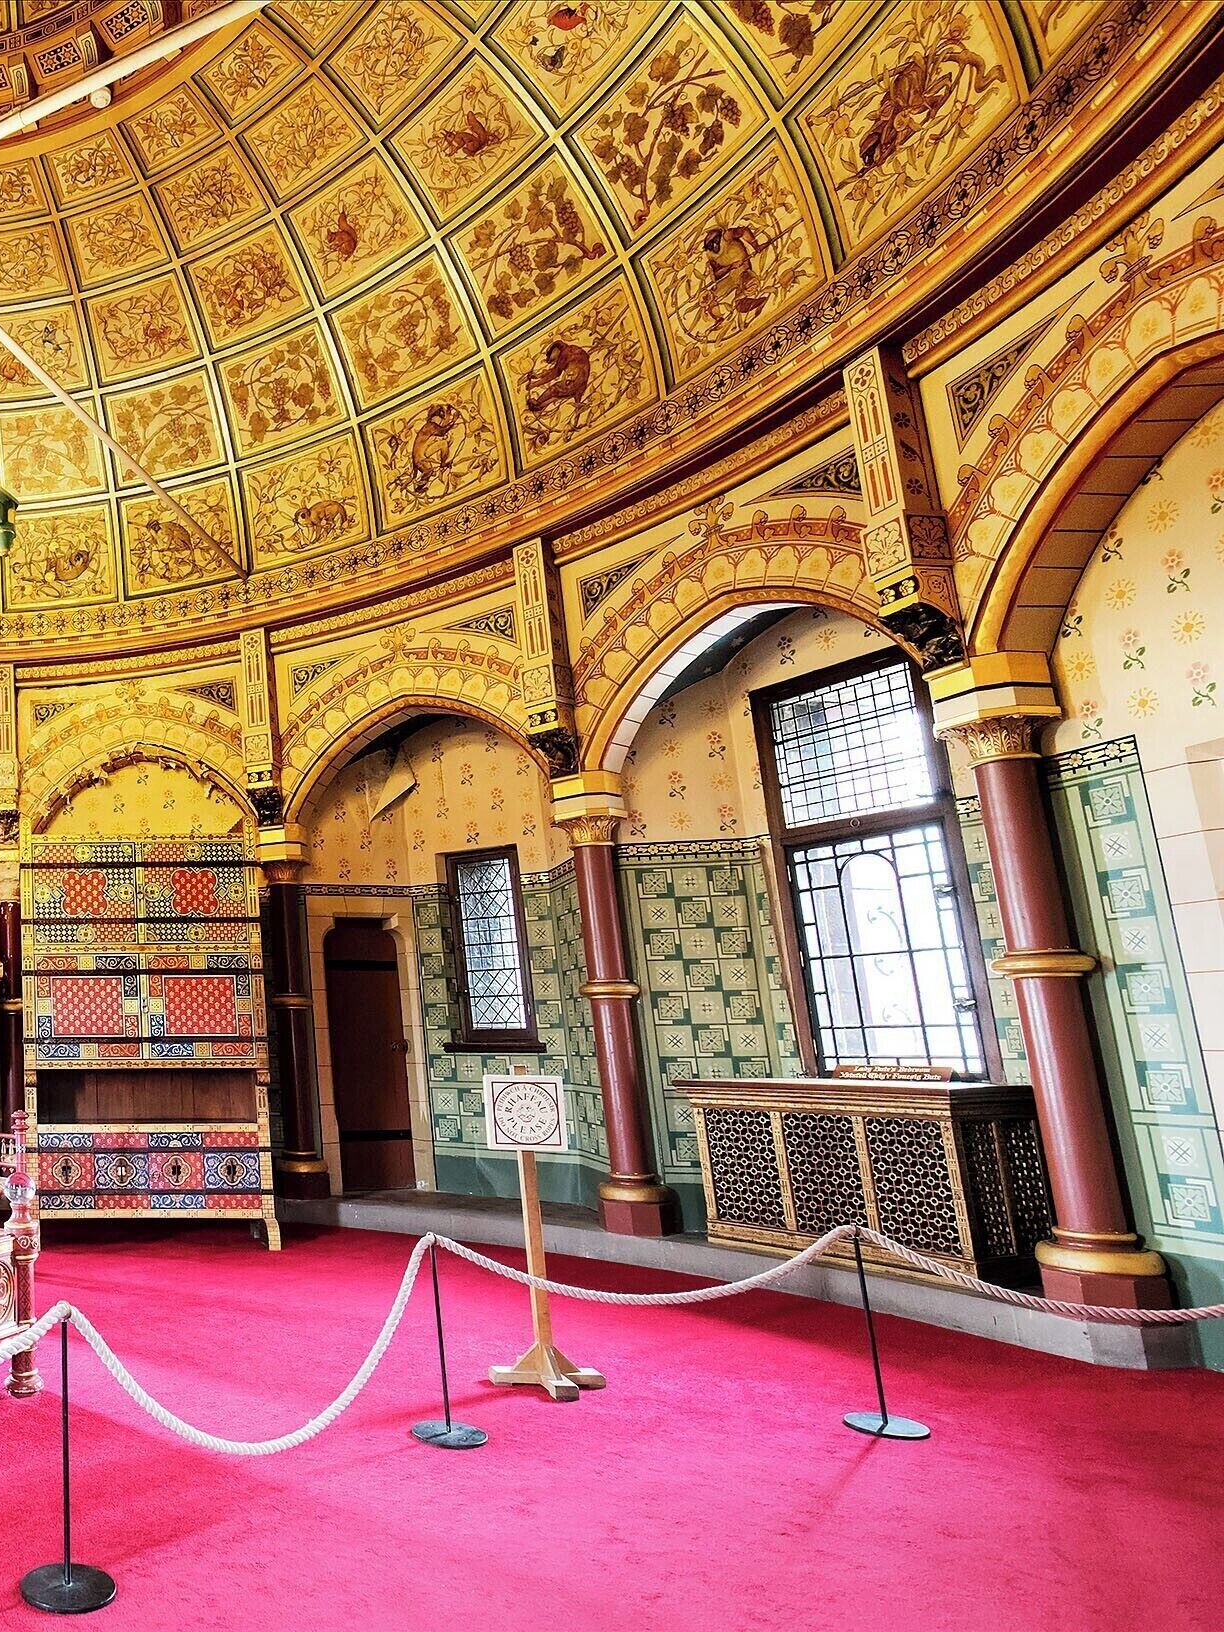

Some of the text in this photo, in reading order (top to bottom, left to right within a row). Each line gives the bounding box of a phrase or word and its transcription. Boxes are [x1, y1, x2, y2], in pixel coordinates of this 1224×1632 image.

[505, 1093, 548, 1114] RHAFFAU
[498, 1117, 555, 1142] DO NOT CROSS ROPES
[507, 1117, 547, 1134] PLEASE
